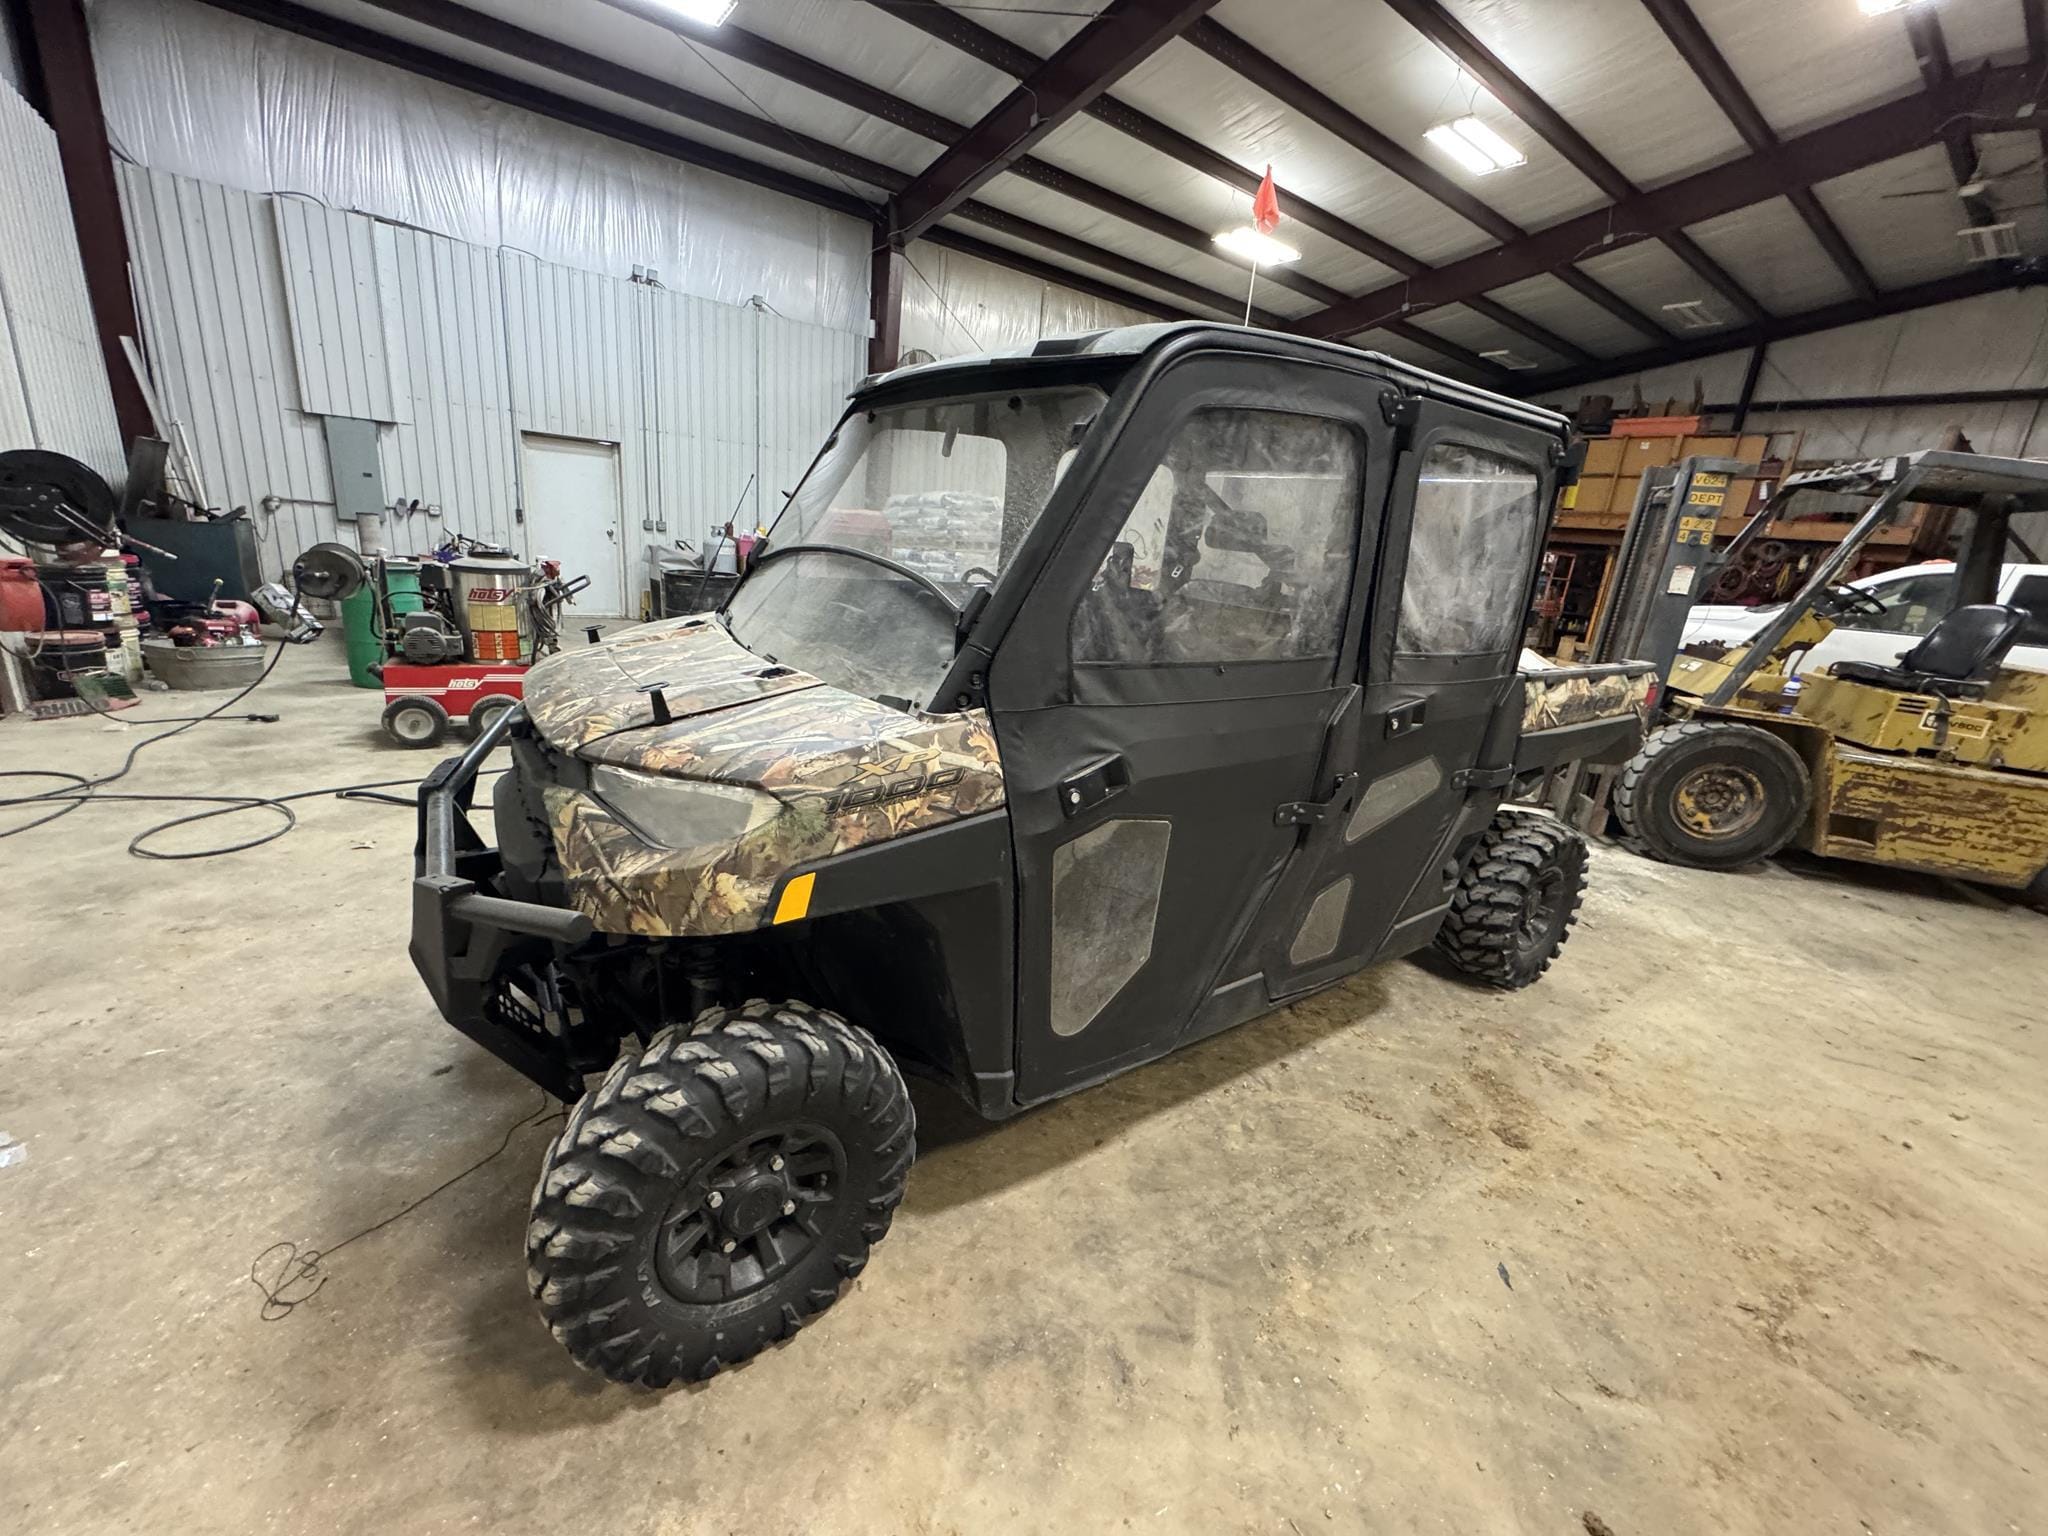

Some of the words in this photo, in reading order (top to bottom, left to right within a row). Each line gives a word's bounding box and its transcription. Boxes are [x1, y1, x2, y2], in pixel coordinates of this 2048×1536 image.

[1689, 493, 1722, 504] DEPT
[467, 588, 514, 602] hotsy
[448, 678, 484, 690] hotsy
[838, 748, 942, 786] XP
[823, 768, 966, 814] 1000
